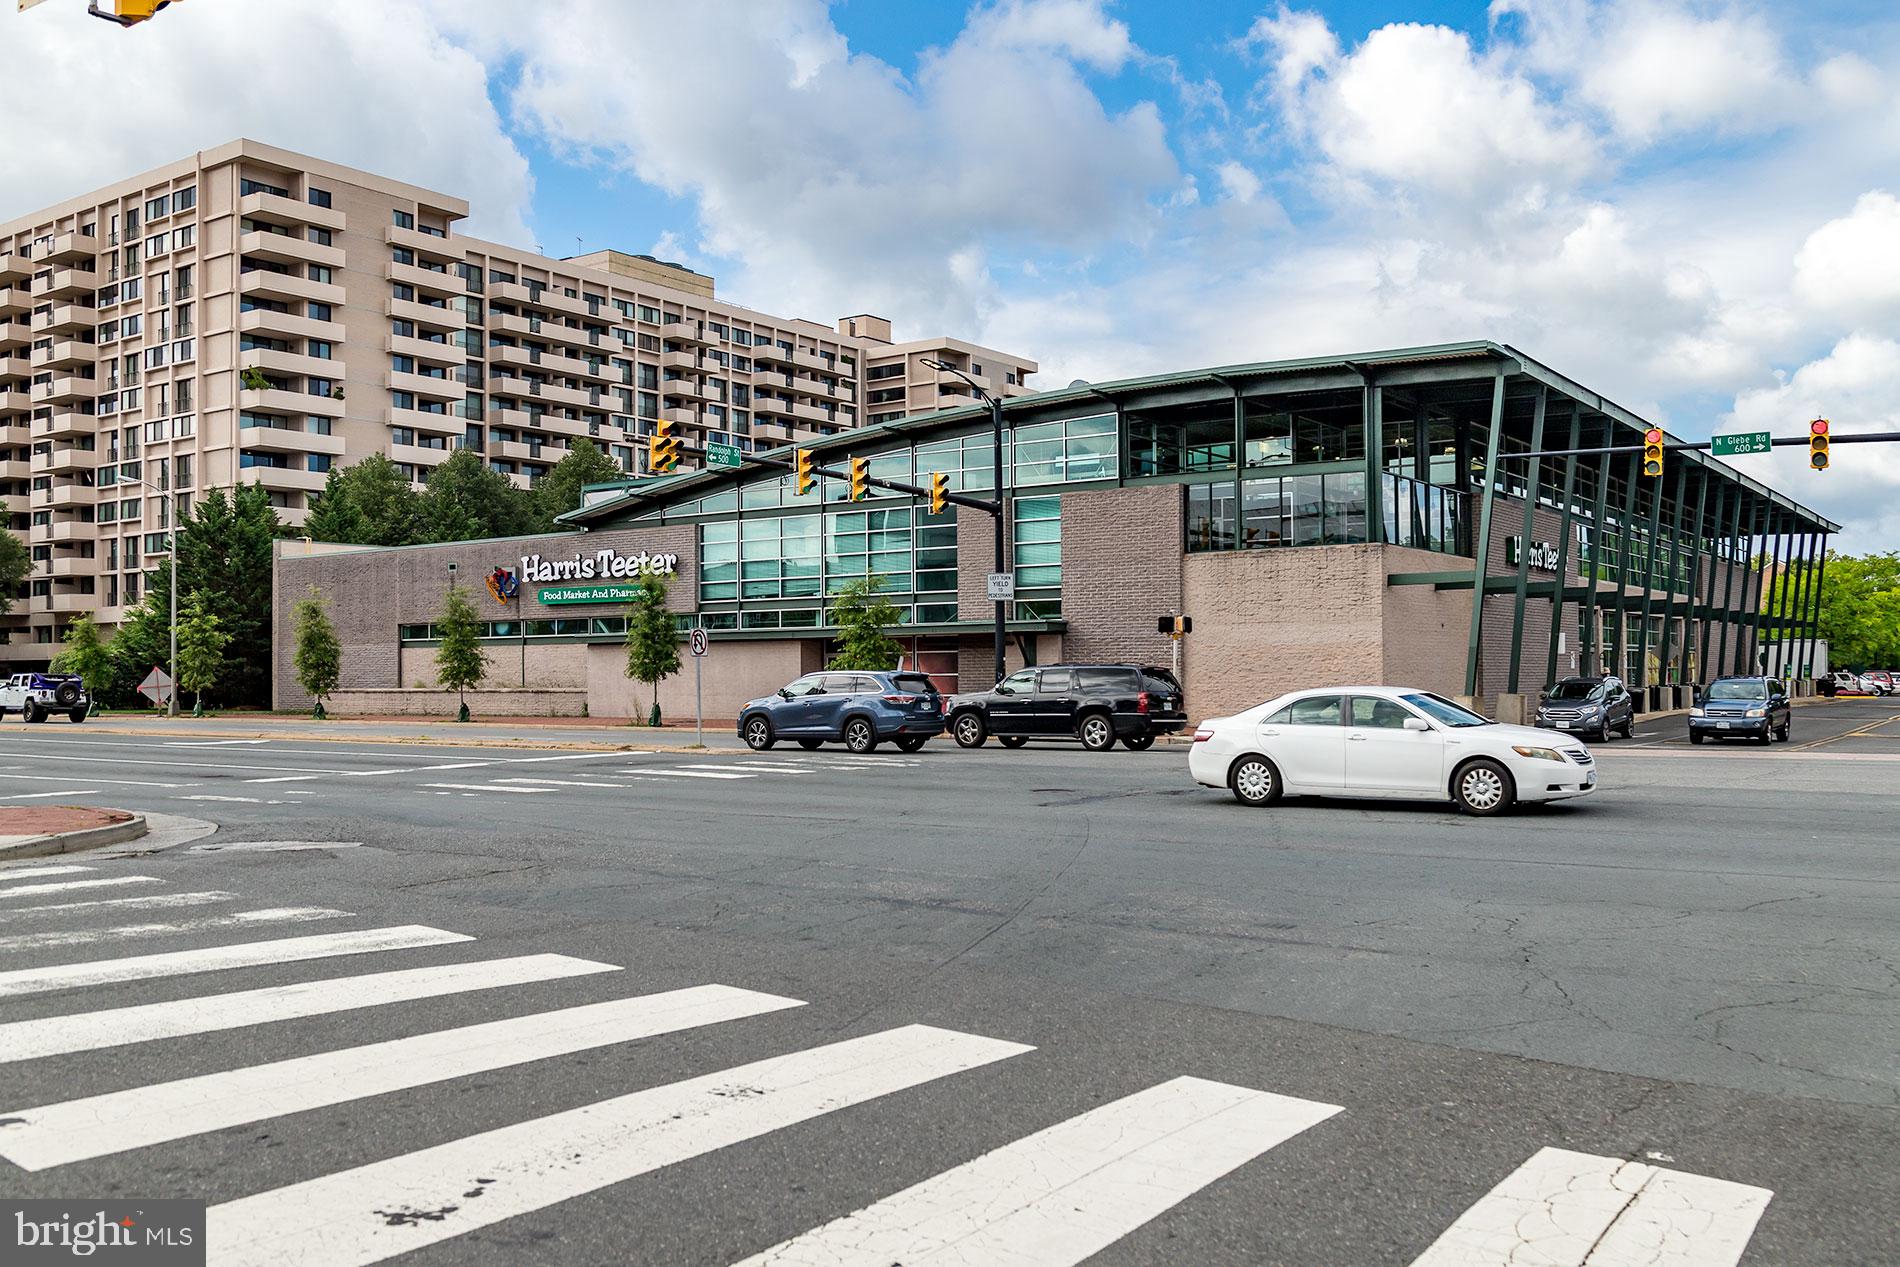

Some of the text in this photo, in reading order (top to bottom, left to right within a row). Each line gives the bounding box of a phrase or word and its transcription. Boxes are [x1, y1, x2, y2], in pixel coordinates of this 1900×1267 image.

[1727, 436, 1750, 445] Glebe
[1755, 434, 1766, 442] Rd
[1734, 444, 1750, 453] 600
[718, 454, 729, 464] 500
[521, 549, 677, 583] Harris Teeter
[543, 590, 561, 601] Food
[562, 588, 590, 600] Market
[591, 587, 608, 599] And
